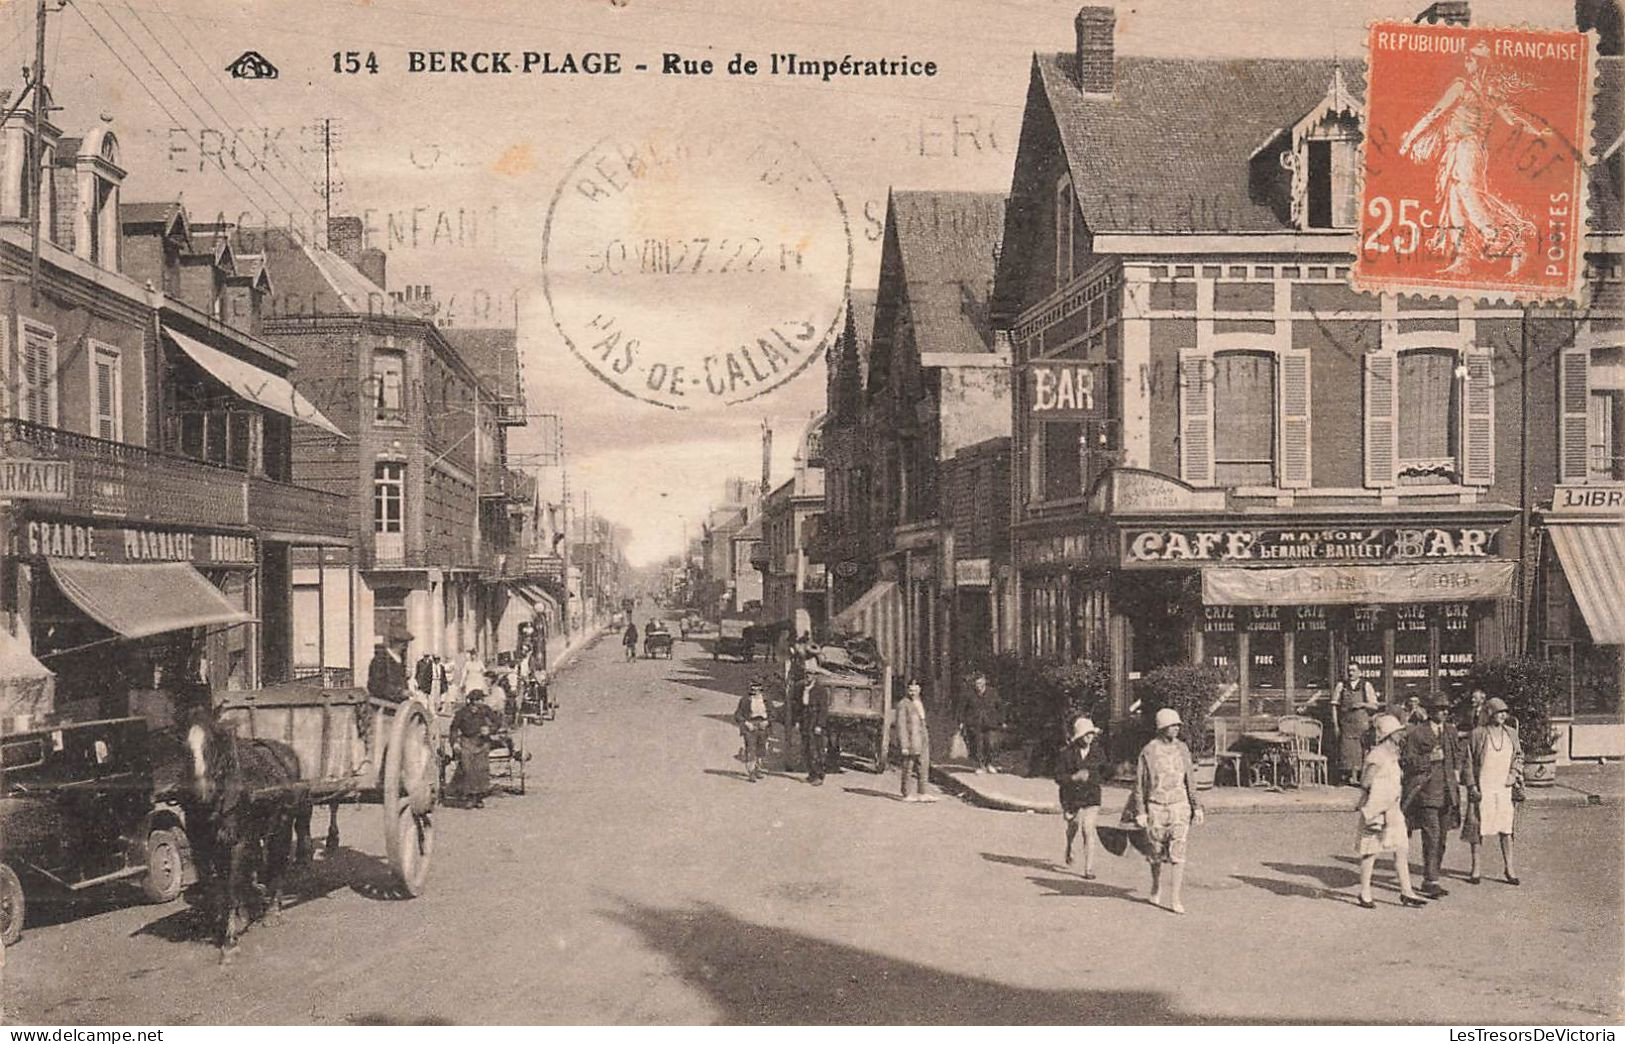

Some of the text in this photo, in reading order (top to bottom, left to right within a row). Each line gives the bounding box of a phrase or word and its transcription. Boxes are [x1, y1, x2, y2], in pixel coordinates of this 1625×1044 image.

[1495, 39, 1577, 60] FRANÇAISE
[1546, 192, 1569, 277] POSTES
[1032, 368, 1095, 412] BAR
[28, 521, 96, 557] GRANDE
[1280, 531, 1363, 541] MAISON
[1394, 528, 1487, 558] BAR
